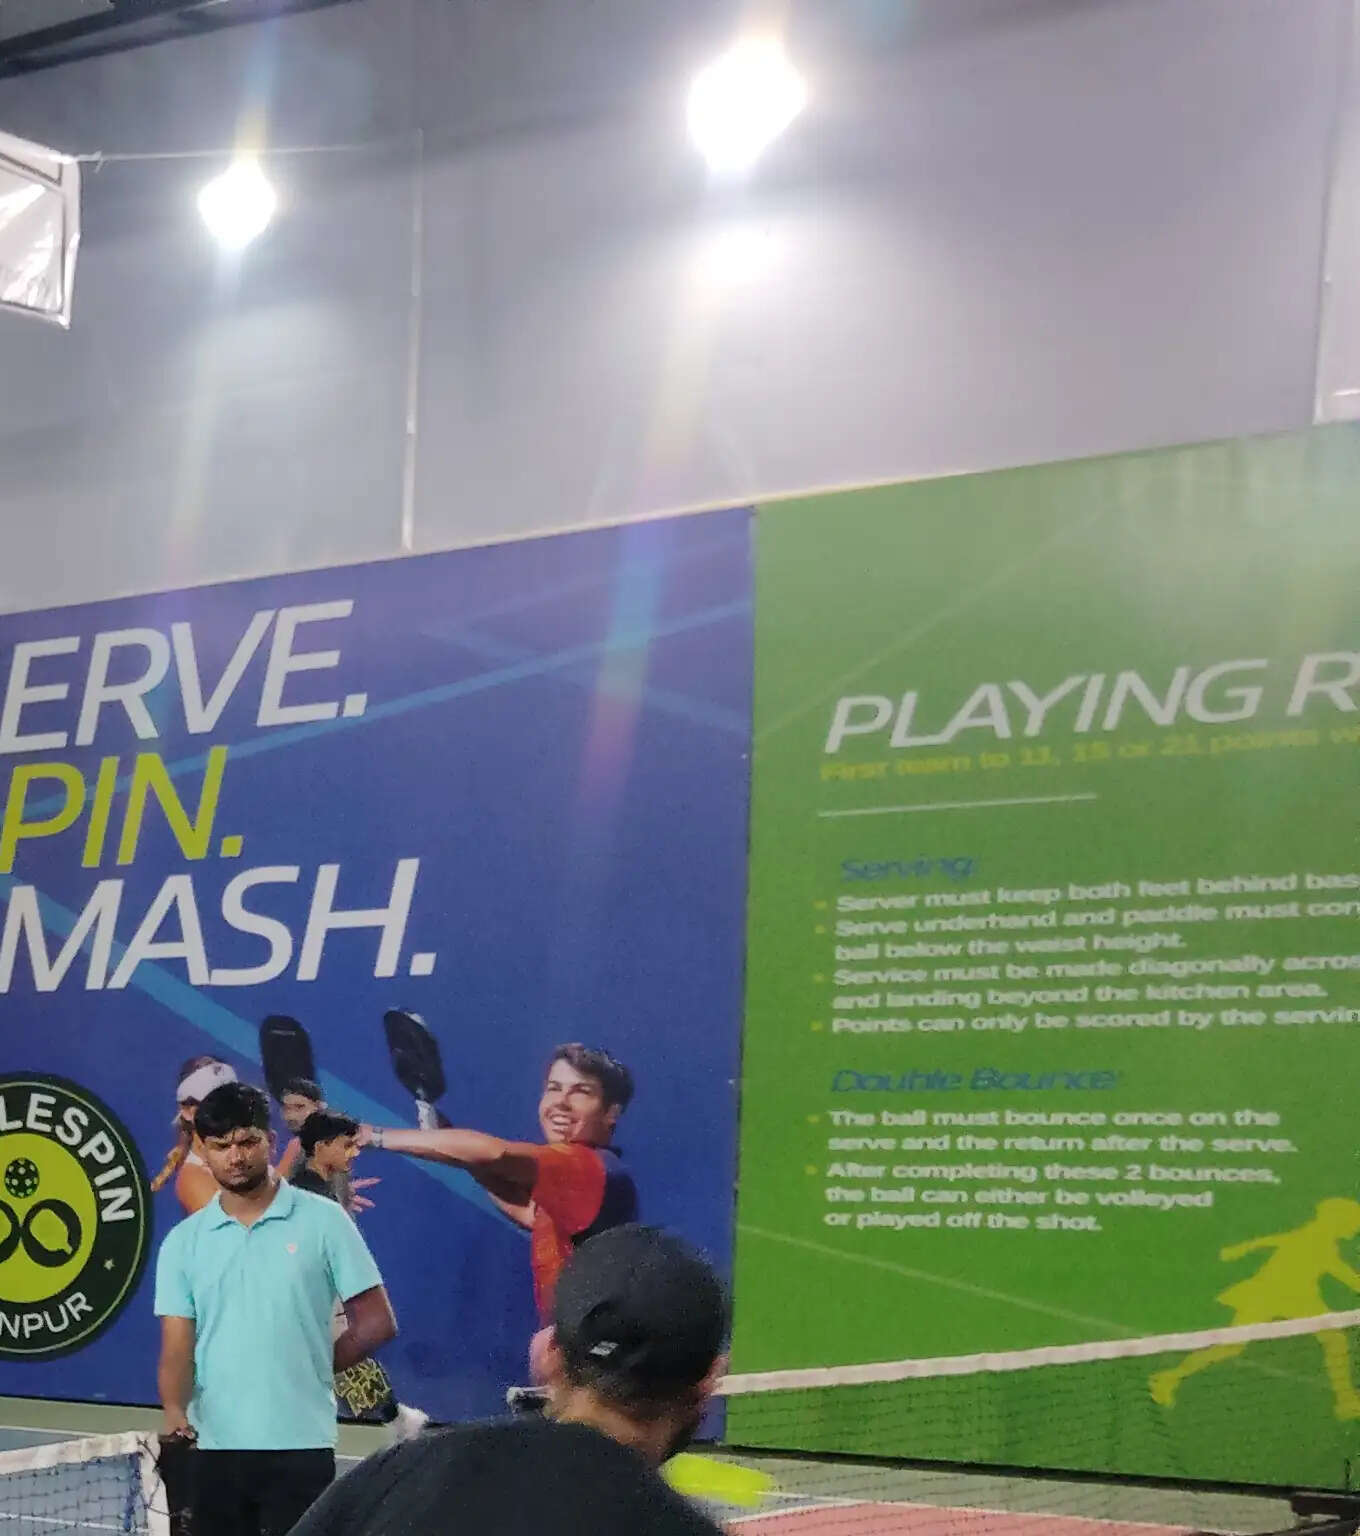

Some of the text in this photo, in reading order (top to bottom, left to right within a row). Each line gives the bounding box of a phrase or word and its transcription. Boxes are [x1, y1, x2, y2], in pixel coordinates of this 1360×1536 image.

[824, 658, 1268, 753] PLAYING
[837, 895, 917, 912] Server
[925, 890, 991, 907] must
[1068, 880, 1130, 900] both
[1197, 873, 1298, 895] behind
[835, 919, 908, 937] Serve
[1063, 907, 1116, 927] and
[1225, 902, 1300, 919] must
[885, 941, 962, 958] below
[834, 968, 928, 985] Service
[934, 964, 1000, 981] must
[1006, 962, 1040, 979] be
[1046, 959, 1123, 978] made
[1130, 954, 1275, 978] diagonally
[833, 993, 880, 1010] and
[1094, 985, 1139, 1001] the
[1145, 983, 1250, 1001] kitchen
[832, 1017, 912, 1033] Points
[917, 1017, 965, 1031] can
[971, 1012, 1029, 1033] only
[1035, 1012, 1069, 1028] be
[1074, 1009, 1171, 1028] scored
[1176, 1009, 1214, 1029] by
[1220, 1007, 1267, 1026] the
[832, 1066, 1118, 1092] Double Bounce
[827, 1108, 1281, 1127] The ball must bounce once on the
[828, 1137, 897, 1151] serve
[901, 1135, 951, 1151] and
[956, 1134, 999, 1151] the
[1004, 1135, 1085, 1151] return
[1090, 1134, 1153, 1151] after
[1158, 1134, 1205, 1151] the
[826, 1162, 887, 1179] After
[892, 1163, 1038, 1183] completing
[1043, 1163, 1119, 1181] these
[1123, 1163, 1143, 1181] 2
[824, 1186, 1214, 1211] the ball can either be volleyed
[823, 1213, 852, 1227] or
[856, 1211, 941, 1231] played
[946, 1212, 983, 1228] off
[987, 1212, 1030, 1229] the
